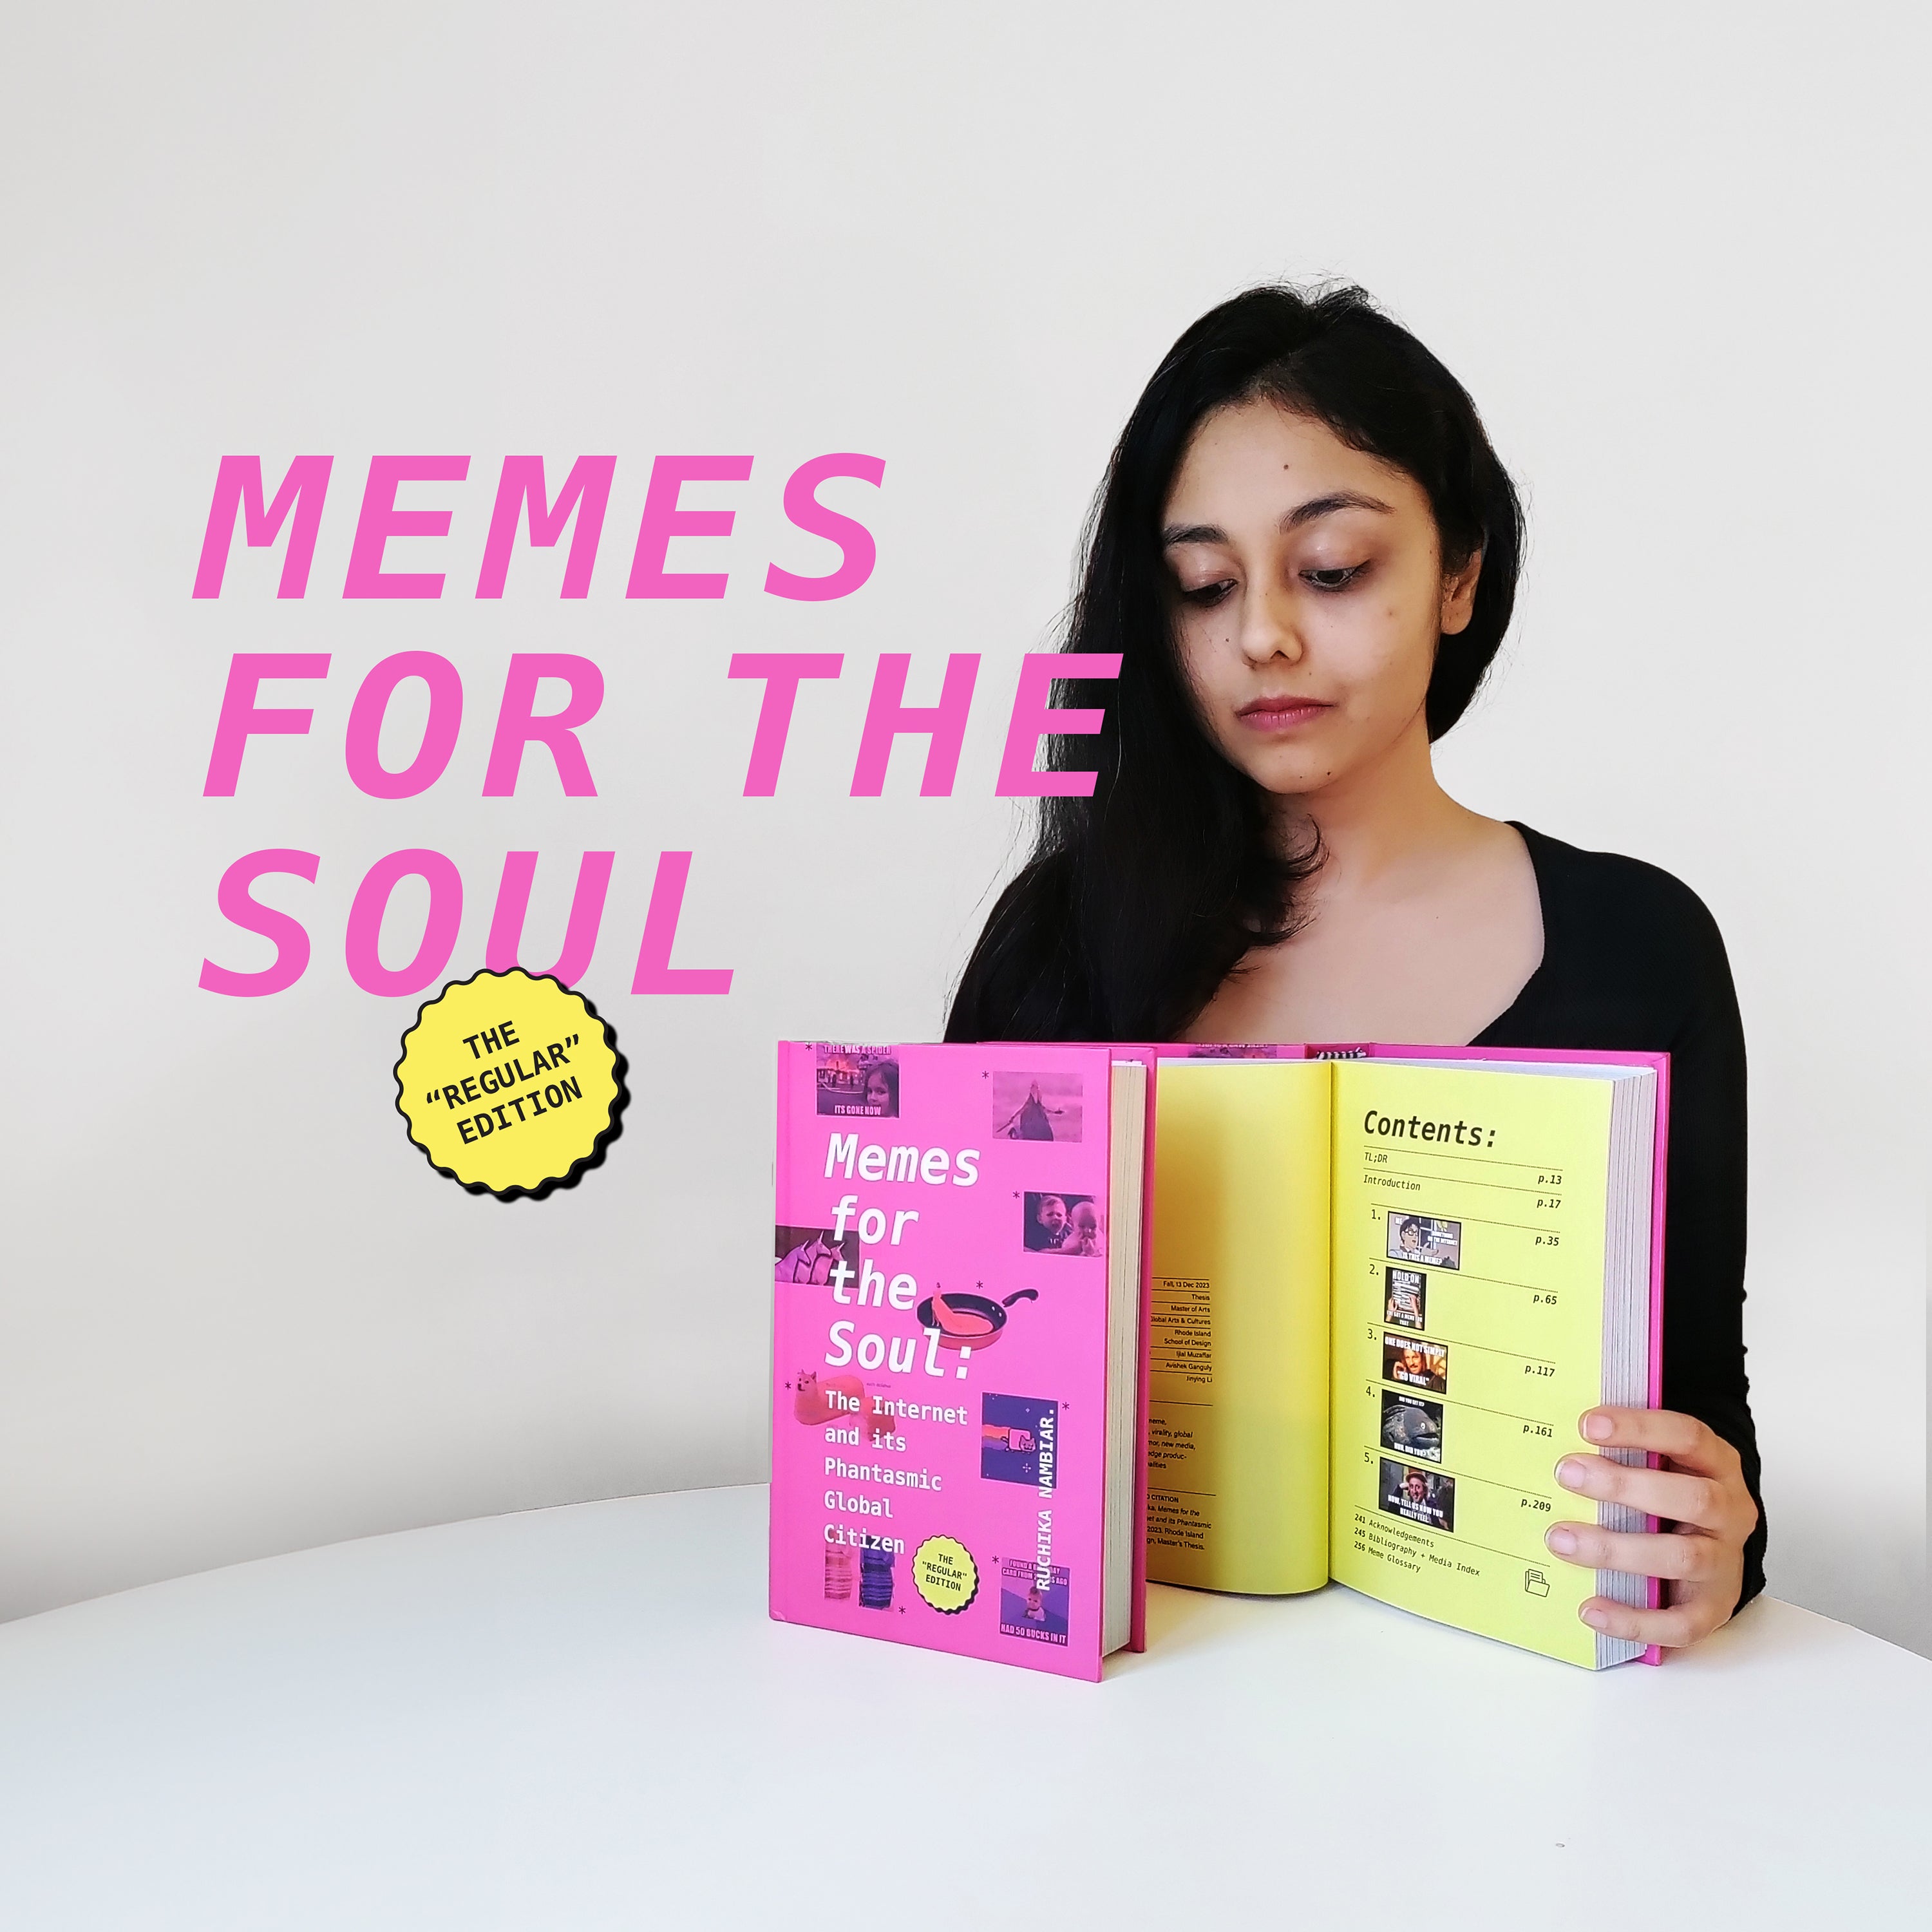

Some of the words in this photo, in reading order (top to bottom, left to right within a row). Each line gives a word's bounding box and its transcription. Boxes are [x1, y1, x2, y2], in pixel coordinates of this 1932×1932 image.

[824, 1045, 844, 1053] THERE
[845, 1045, 860, 1054] WAS
[867, 1046, 891, 1054] SPIDER
[835, 1105, 846, 1113] ITS
[846, 1106, 864, 1115] GONE
[865, 1106, 881, 1115] NOW
[1364, 1110, 1495, 1148] Contents:
[824, 1132, 980, 1187] Memes
[1365, 1152, 1388, 1163] TL;DR
[1538, 1175, 1562, 1185] p.13
[1363, 1175, 1421, 1191] Introduction
[1537, 1199, 1561, 1209] p.17
[831, 1195, 920, 1245] for
[1371, 1209, 1381, 1220] 1.
[1535, 1236, 1559, 1246] p.35
[829, 1259, 917, 1310] the
[1369, 1264, 1379, 1276] 2.
[1533, 1294, 1557, 1305] p.65
[1392, 1270, 1409, 1282] HOLD
[1410, 1274, 1419, 1283] ON
[824, 1320, 971, 1379] Soul:
[1367, 1329, 1377, 1340] 3.
[1525, 1365, 1555, 1377] p.117
[1385, 1336, 1396, 1347] ONE
[1396, 1339, 1411, 1350] DOES
[1411, 1341, 1423, 1352] NOT
[1423, 1345, 1444, 1358] SIMPLY
[1188, 1363, 1212, 1372] Ganguly
[825, 1390, 860, 1412] The
[873, 1396, 967, 1425] Internet
[1366, 1386, 1376, 1397] 4.
[1523, 1425, 1552, 1437] p.161
[825, 1427, 859, 1445] and
[872, 1428, 906, 1451] its
[1039, 1410, 1054, 1498] NAMBIAR.
[825, 1457, 942, 1491] Phantasmic
[1364, 1452, 1374, 1464] 5.
[1520, 1499, 1551, 1512] p.209
[824, 1491, 893, 1518] Global
[1151, 1494, 1179, 1503] CITATION
[1157, 1505, 1179, 1514] Memes
[1401, 1499, 1411, 1508] TELL
[1412, 1502, 1419, 1510] US
[1433, 1508, 1443, 1518] YOU
[824, 1524, 904, 1554] Citizen
[1164, 1528, 1184, 1537] Rhode
[1186, 1530, 1204, 1539] Island
[1177, 1519, 1211, 1529] Phantasmic
[1354, 1513, 1366, 1524] 241
[1368, 1519, 1434, 1548] Acknowledgements
[938, 1553, 953, 1565] THE
[1010, 1560, 1027, 1569] FOUND
[1036, 1510, 1052, 1591] RUCHIKA
[1354, 1527, 1365, 1537] 245
[1368, 1533, 1417, 1558] Bibliography
[1428, 1554, 1452, 1567] Media
[1456, 1563, 1481, 1577] Index
[1354, 1540, 1365, 1551] 256
[1368, 1546, 1384, 1558] Meme
[1387, 1555, 1421, 1573] Glossary
[926, 1575, 961, 1591] EDITION
[1001, 1624, 1014, 1634] HAD
[1016, 1627, 1025, 1636] 50
[1026, 1628, 1049, 1640] BUCKS
[1050, 1633, 1058, 1642] IN
[1059, 1634, 1066, 1643] IT
